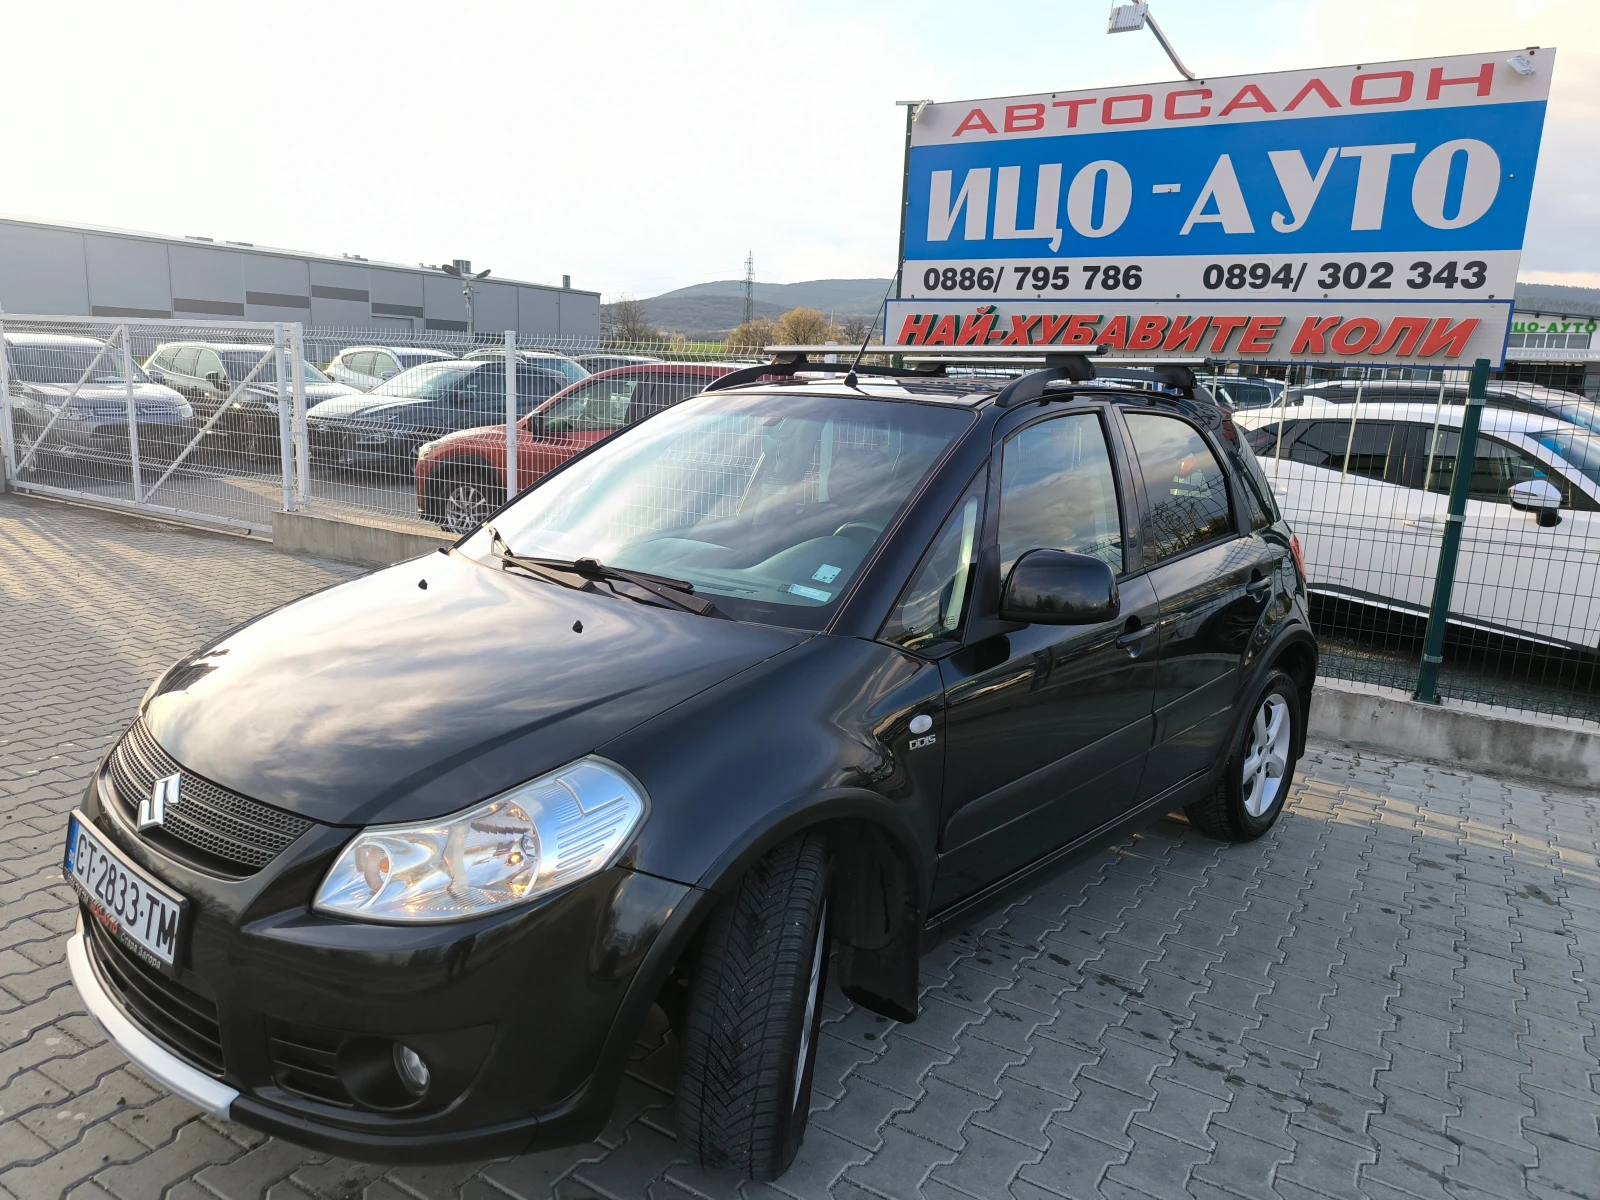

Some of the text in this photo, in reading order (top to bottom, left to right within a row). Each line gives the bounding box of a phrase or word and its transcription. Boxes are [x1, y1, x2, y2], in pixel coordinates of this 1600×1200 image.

[952, 62, 1495, 137] АВТОСАЛОН
[1013, 266, 1069, 290] 795
[1082, 265, 1143, 290] 786
[1317, 261, 1394, 290] 302
[1406, 260, 1488, 289] 343
[896, 305, 1481, 358] НАЙ-ХУБАВИТЕ КОЛИ
